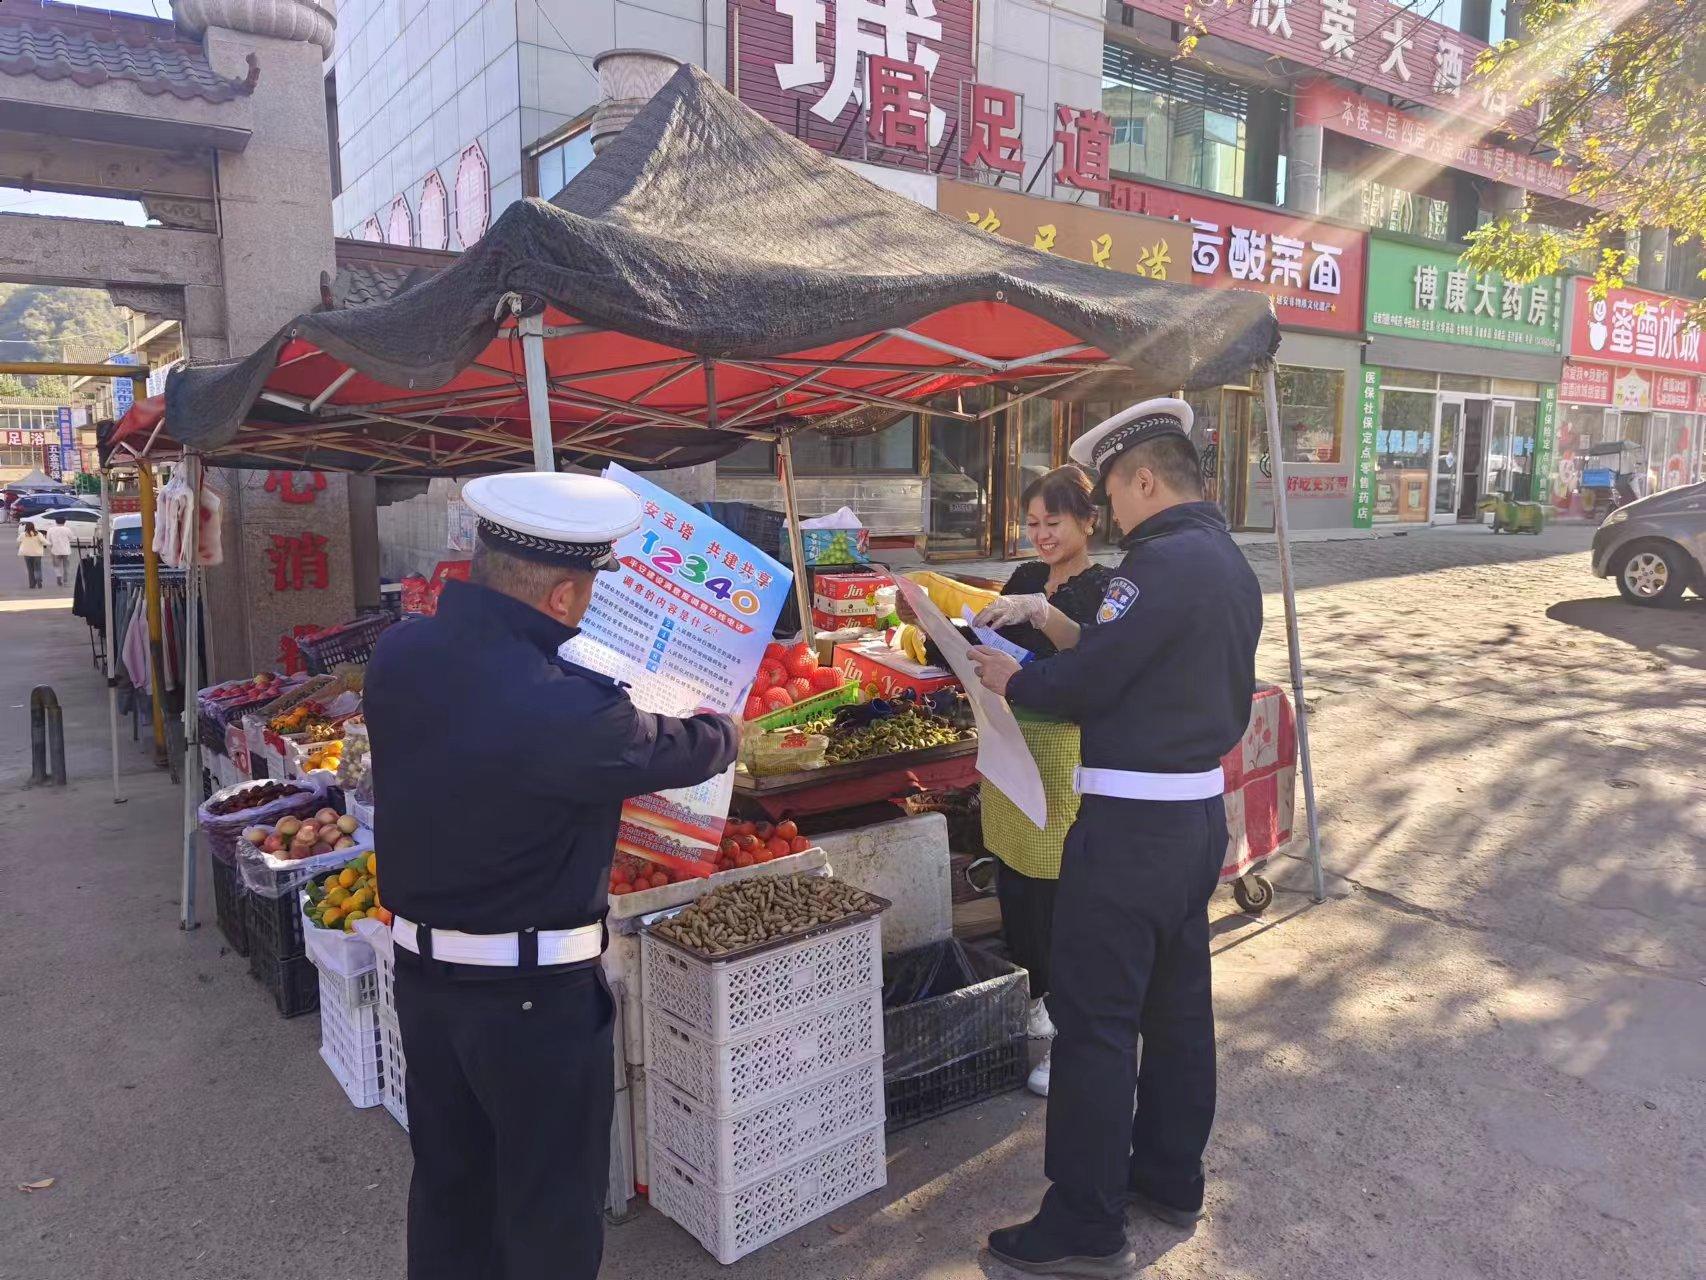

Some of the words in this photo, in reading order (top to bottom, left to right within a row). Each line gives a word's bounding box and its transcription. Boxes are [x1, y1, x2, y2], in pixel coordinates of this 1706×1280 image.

[1412, 263, 1550, 328] 博康大药房
[8, 433, 45, 446] 足浴
[1357, 371, 1376, 519] 医保社保定点零售药店
[640, 528, 761, 616] 12340
[644, 499, 696, 541] 安宝塔
[705, 541, 775, 591] 共建共享
[843, 584, 865, 598] Jin
